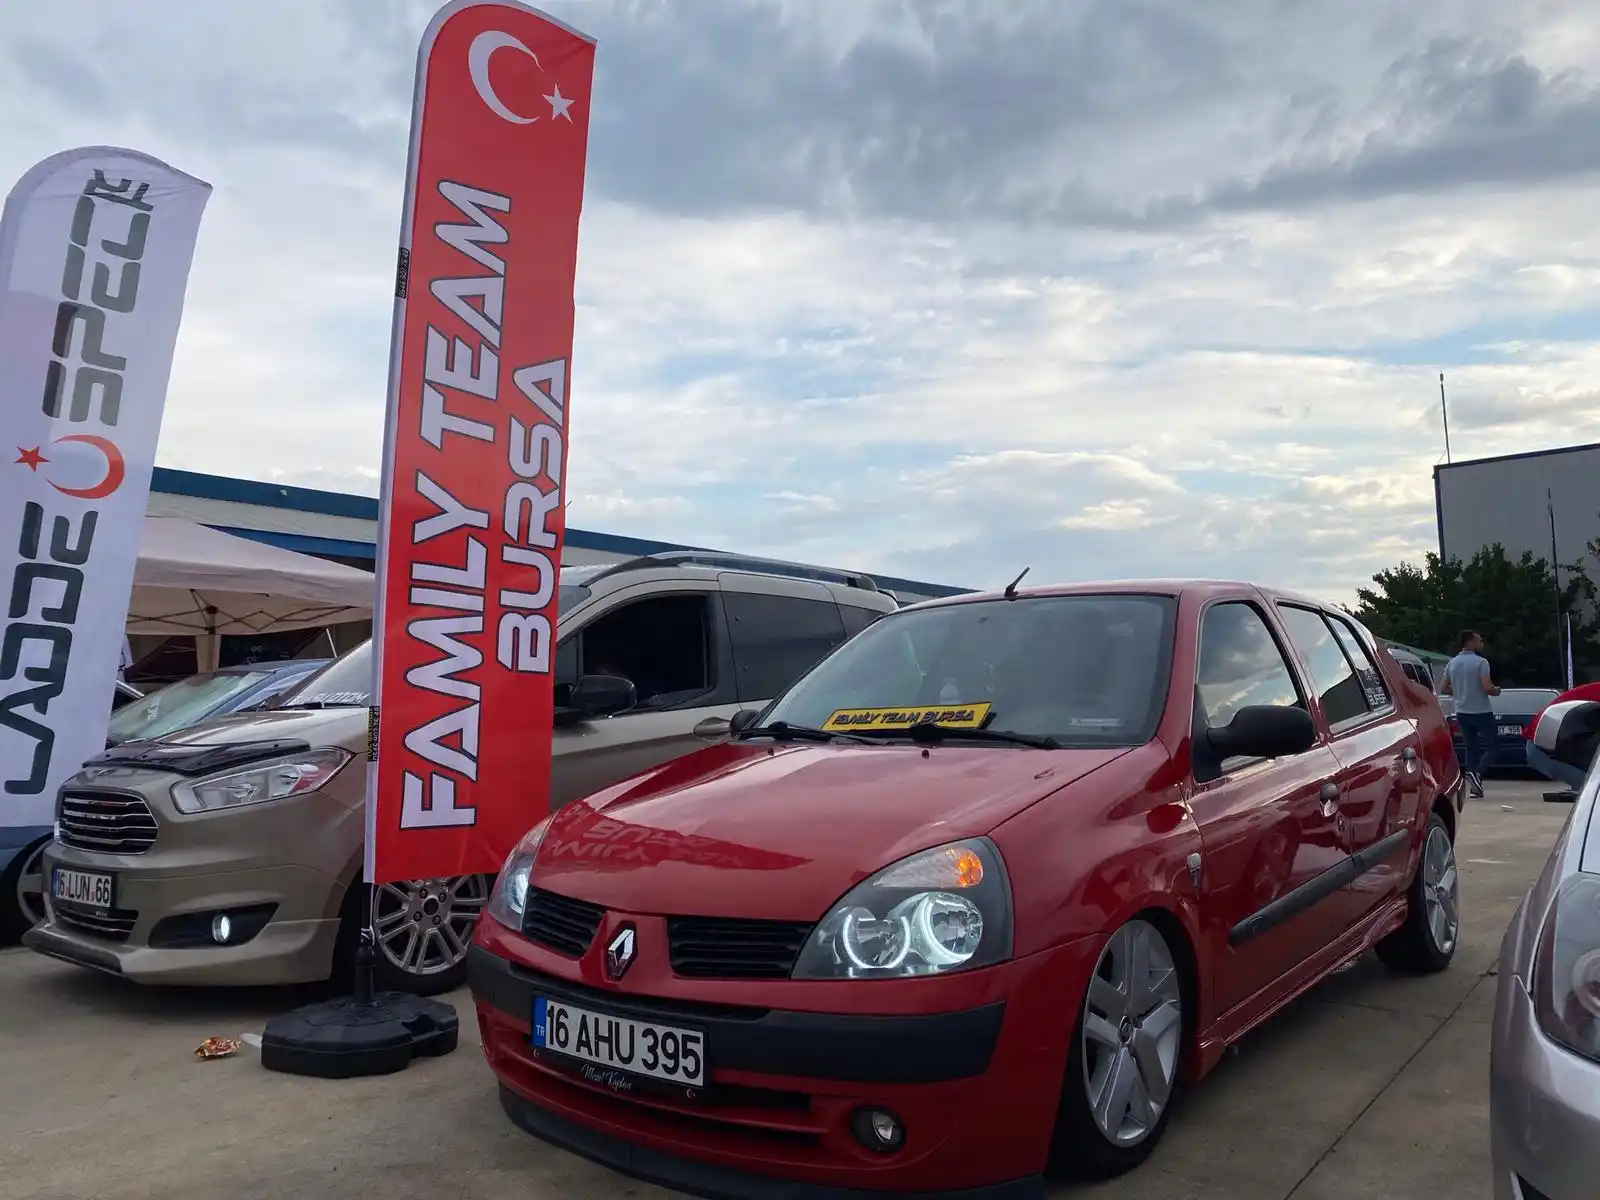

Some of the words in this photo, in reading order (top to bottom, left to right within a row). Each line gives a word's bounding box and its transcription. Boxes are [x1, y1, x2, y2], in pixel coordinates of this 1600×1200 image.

[420, 178, 512, 448] TEAM
[496, 356, 567, 674] BURSA
[400, 468, 490, 830] FAMILY
[880, 711, 920, 723] TEAM
[921, 709, 975, 723] BURSA
[57, 871, 65, 896] 16
[68, 873, 90, 901] LUN
[96, 877, 110, 904] 66
[536, 1024, 545, 1037] TR
[547, 1005, 569, 1048] 16
[576, 1014, 635, 1064] AHU
[641, 1027, 700, 1079] 395
